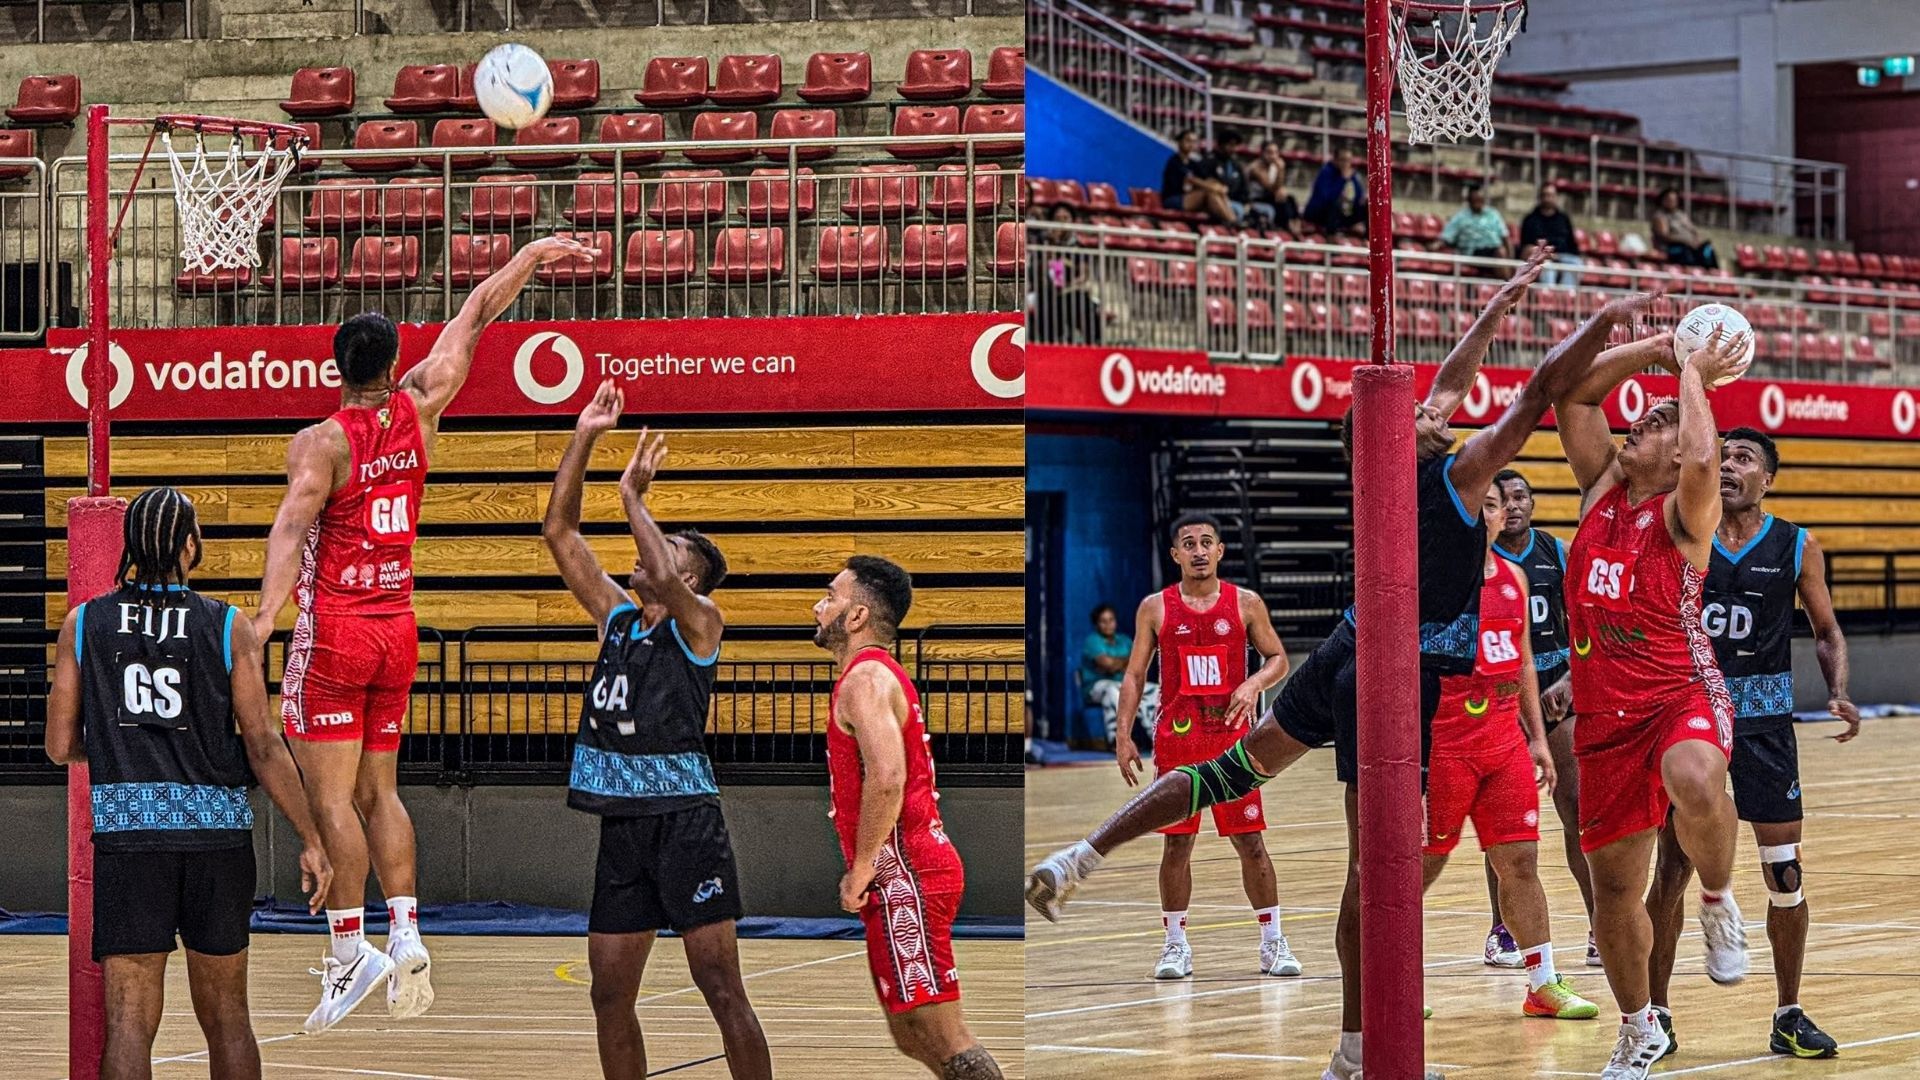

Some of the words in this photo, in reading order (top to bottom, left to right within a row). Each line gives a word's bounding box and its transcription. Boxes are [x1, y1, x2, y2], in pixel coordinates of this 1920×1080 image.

[145, 350, 342, 391] vodafone
[595, 353, 706, 381] Together
[710, 357, 746, 374] we
[752, 354, 796, 374] can
[1136, 364, 1226, 396] vodafone
[1786, 394, 1849, 422] vodafone
[360, 449, 419, 483] TONGA
[371, 494, 410, 534] GA
[1587, 557, 1625, 600] GS
[117, 602, 190, 644] FIJI
[1530, 595, 1549, 624] D
[1701, 602, 1753, 639] GD
[1186, 655, 1222, 686] WA
[123, 663, 183, 719] GS
[592, 674, 629, 711] GA
[319, 711, 354, 726] TDB
